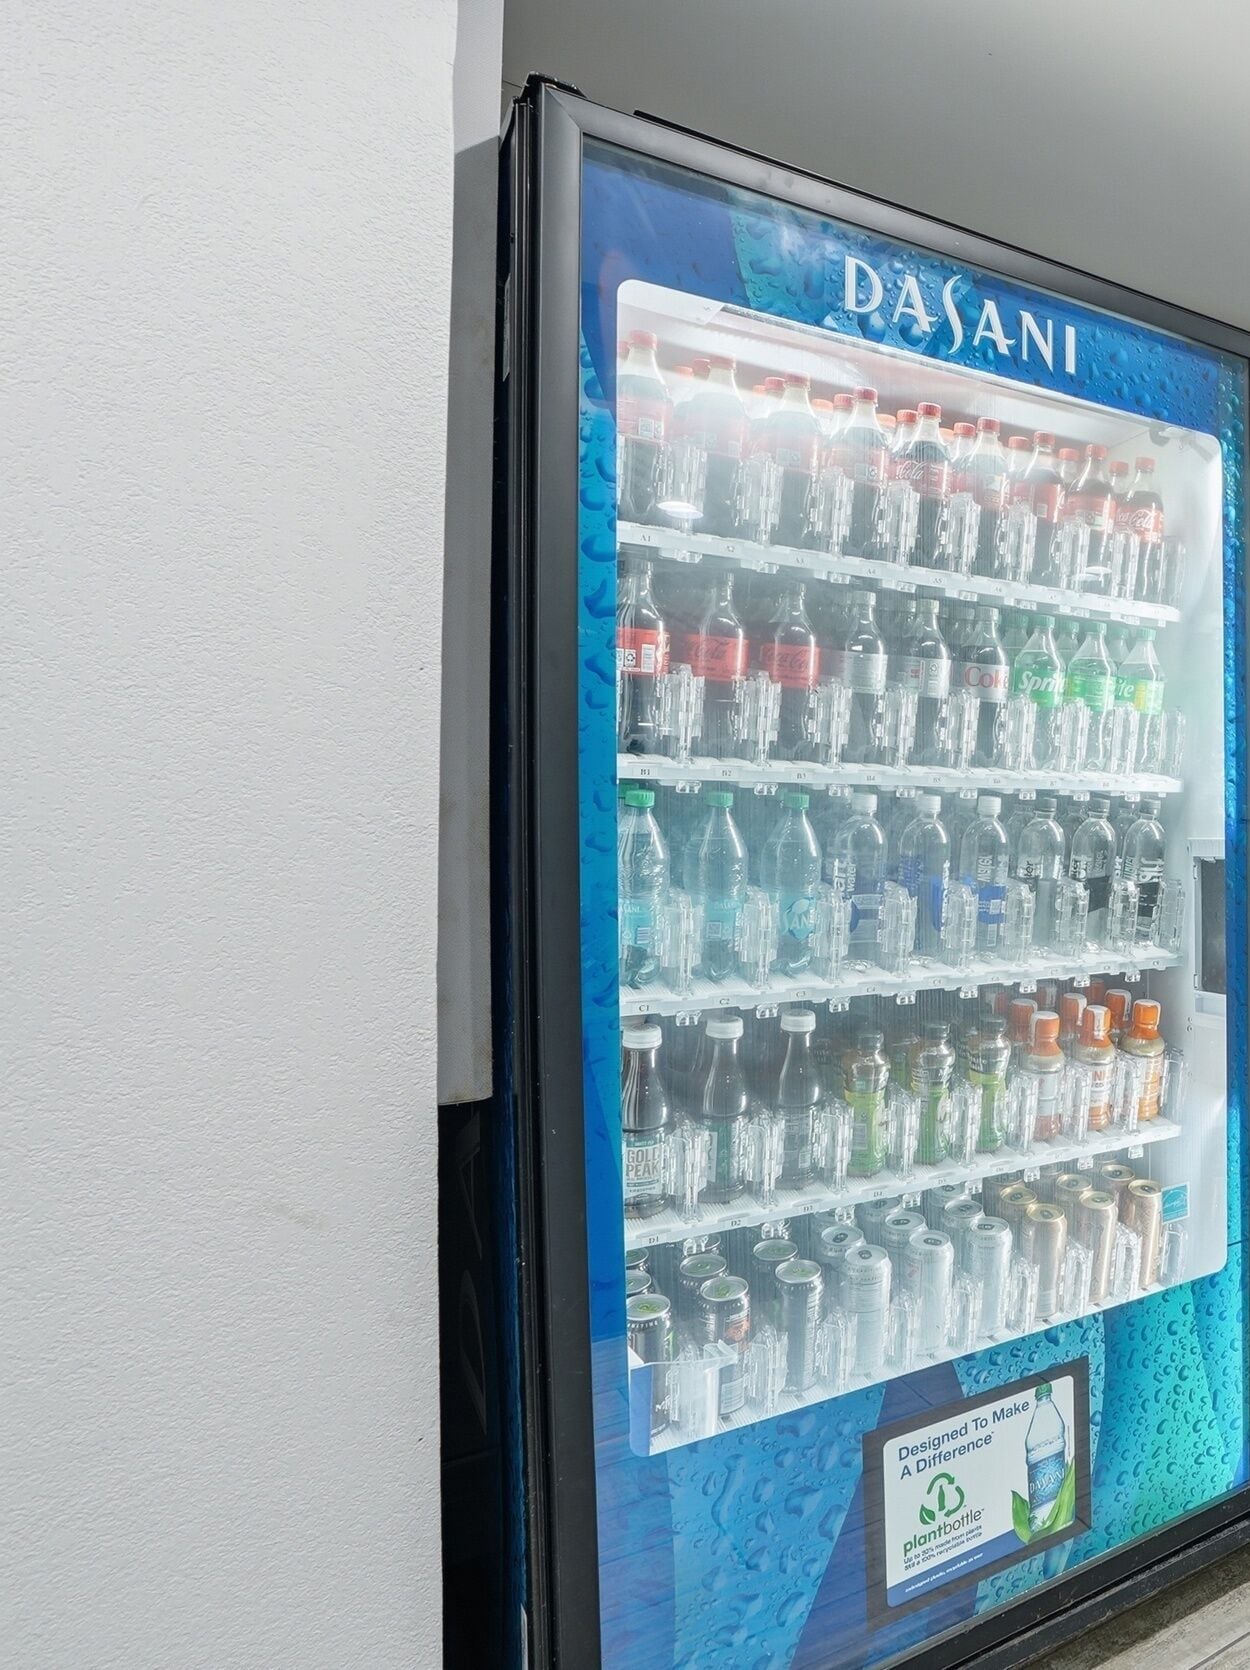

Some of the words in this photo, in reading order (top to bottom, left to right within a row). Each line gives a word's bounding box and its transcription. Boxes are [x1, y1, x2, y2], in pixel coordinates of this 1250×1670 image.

[843, 255, 1080, 378] DASANI
[640, 768, 651, 776] B1
[638, 1003, 650, 1013] C1
[626, 1160, 659, 1178] PEAK
[648, 1236, 660, 1245] D1
[898, 1421, 969, 1462] Designed
[971, 1416, 989, 1432] To
[992, 1399, 1030, 1425] Make
[900, 1463, 912, 1480] A
[903, 1508, 983, 1558] plantbottle
